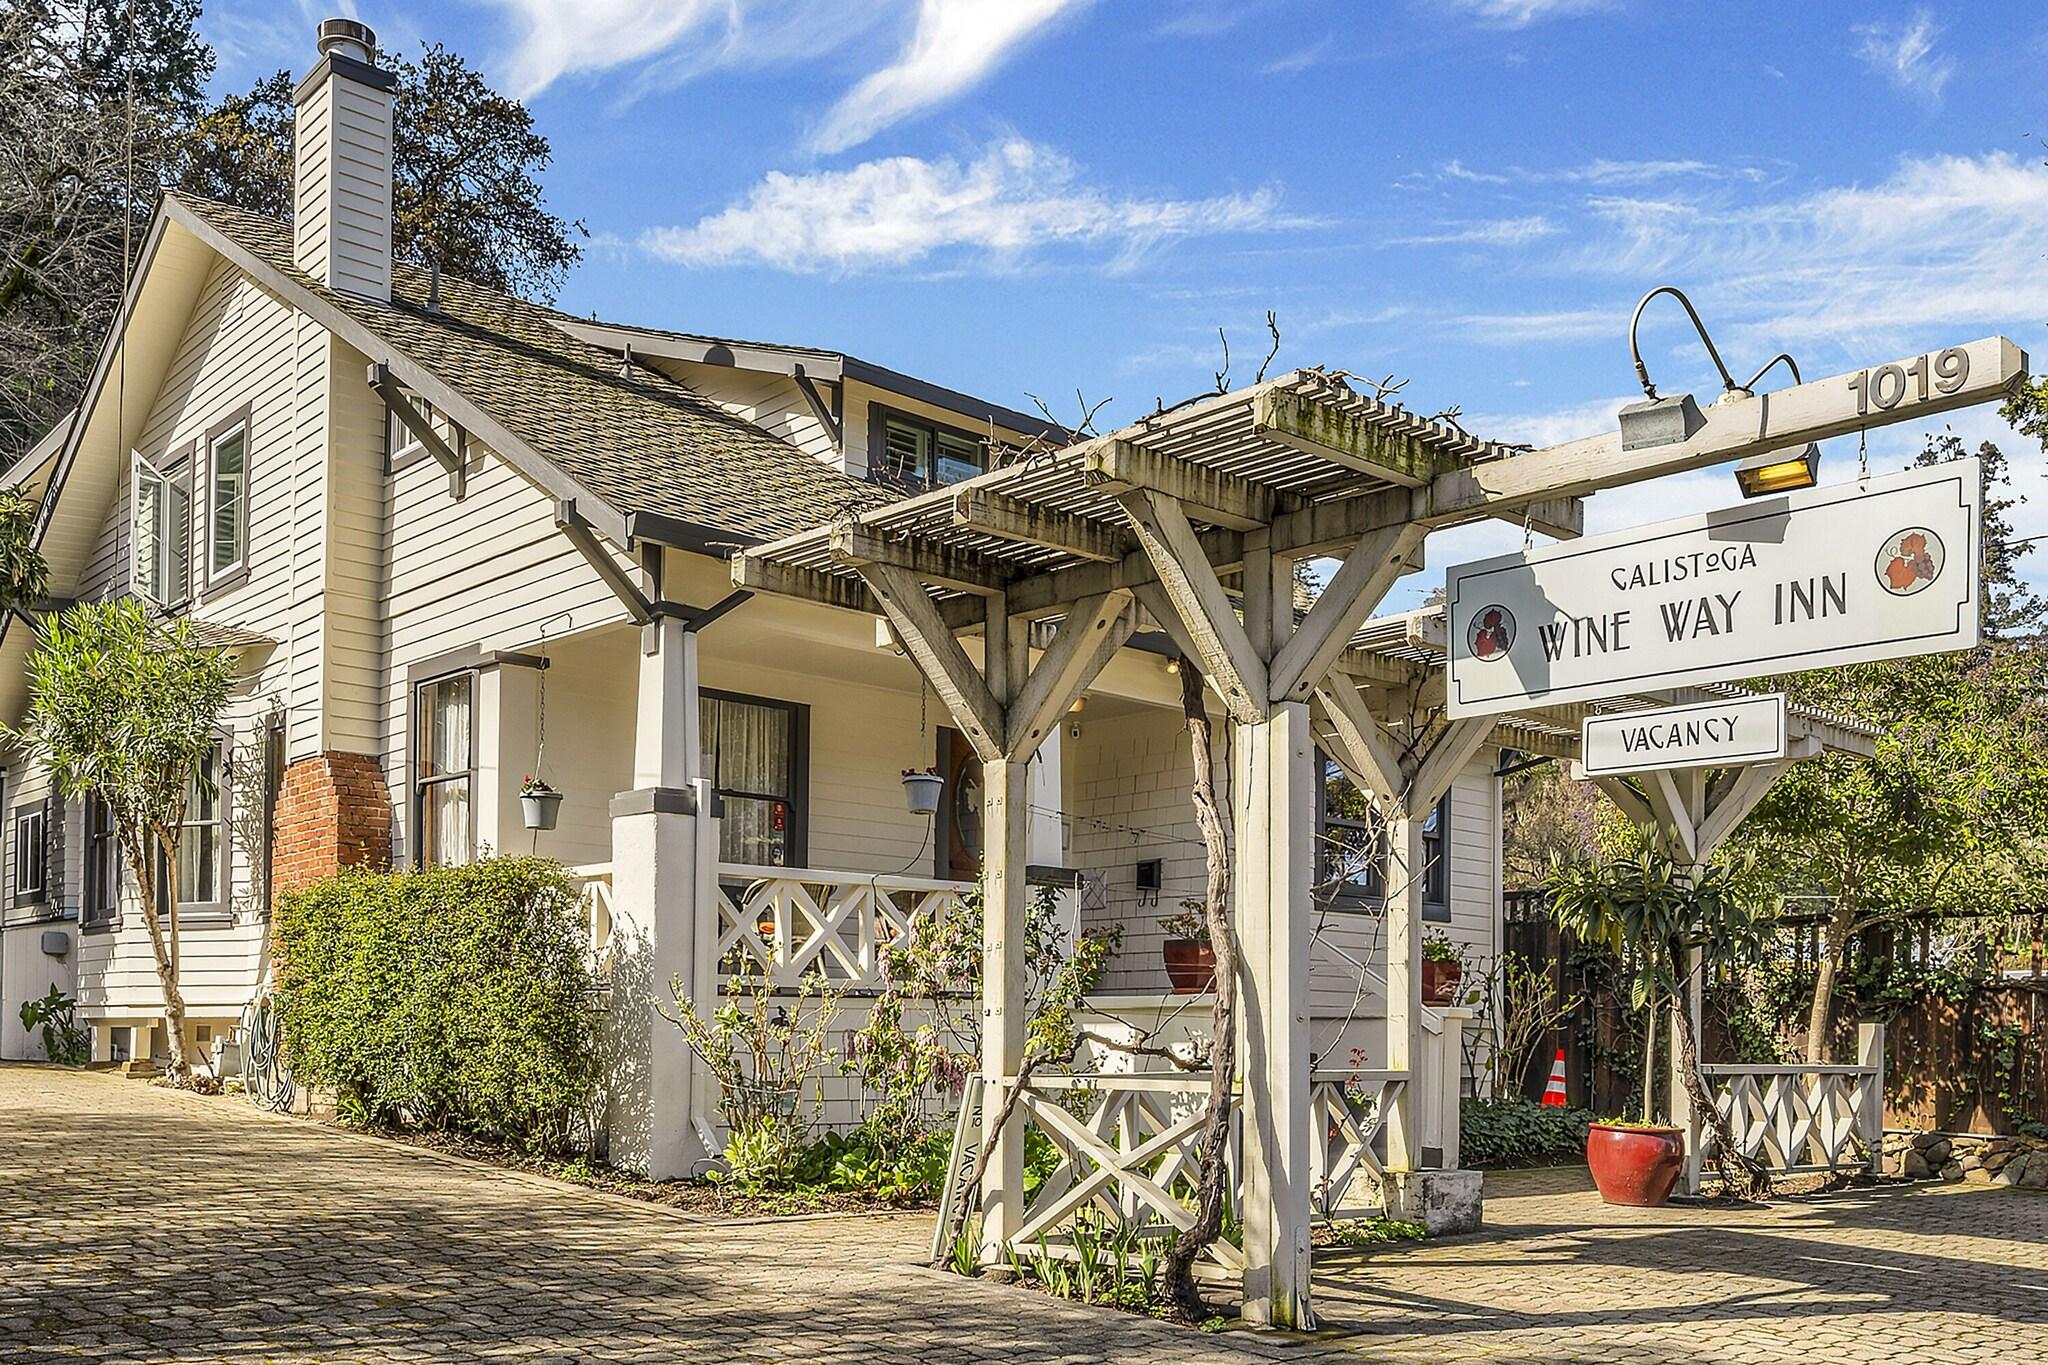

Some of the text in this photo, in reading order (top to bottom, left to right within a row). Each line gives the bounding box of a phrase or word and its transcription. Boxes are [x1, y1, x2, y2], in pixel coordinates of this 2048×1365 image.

[1848, 347, 1970, 415] 1019
[1538, 572, 1847, 662] WINE WAY INN
[1620, 715, 1739, 752] VACANCY
